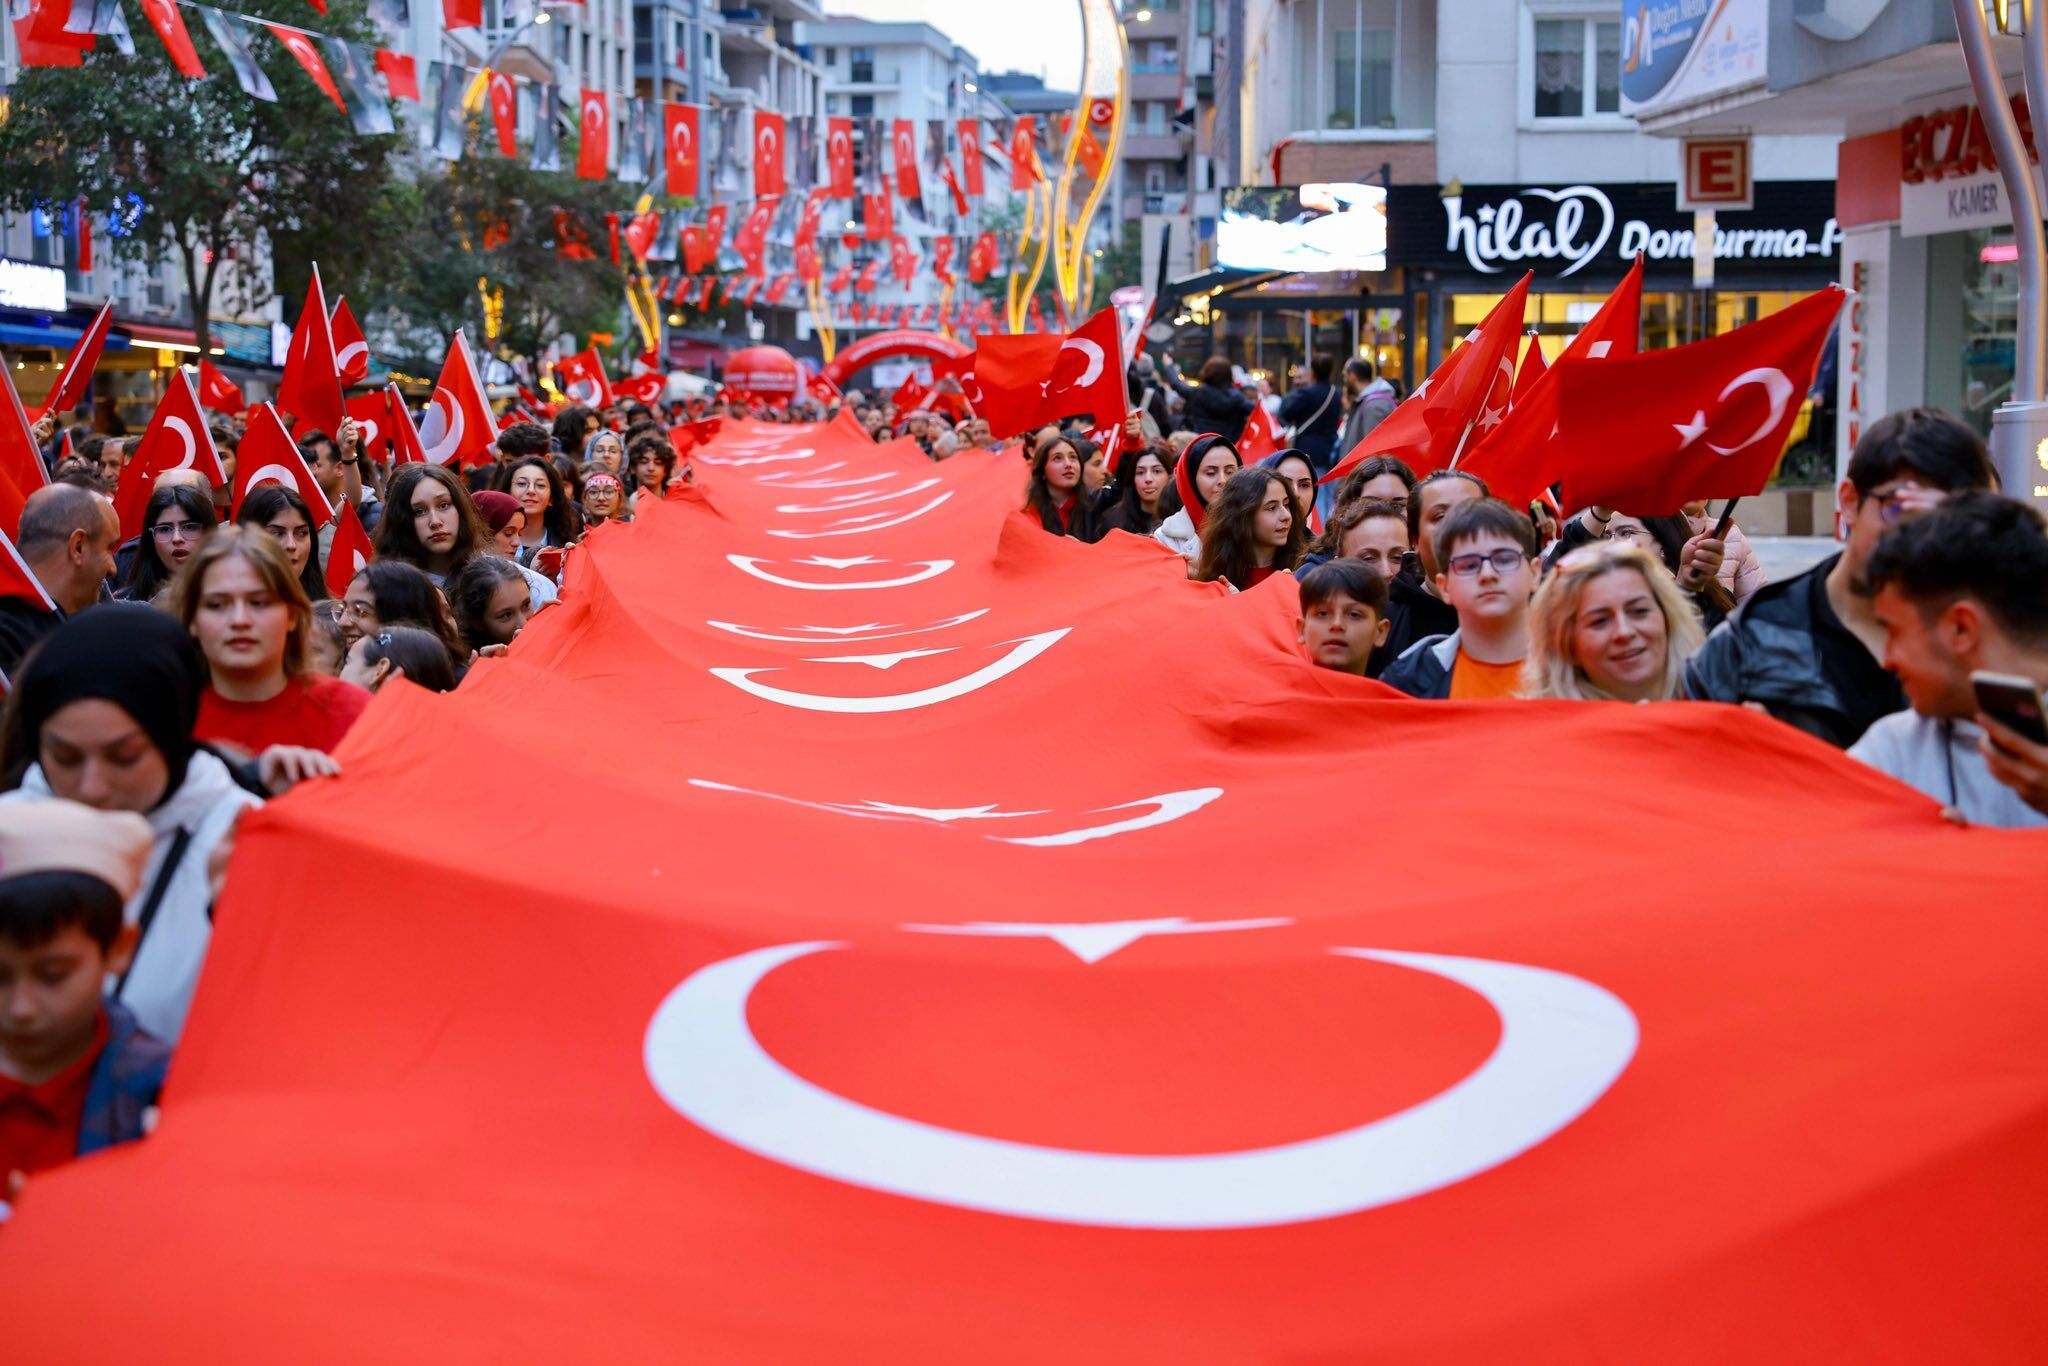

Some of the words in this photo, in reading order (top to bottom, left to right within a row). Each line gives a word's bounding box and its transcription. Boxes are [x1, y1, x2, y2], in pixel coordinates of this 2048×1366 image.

[1699, 150, 1735, 194] E
[1948, 183, 1999, 219] KAMER
[1441, 190, 1600, 275] hilal
